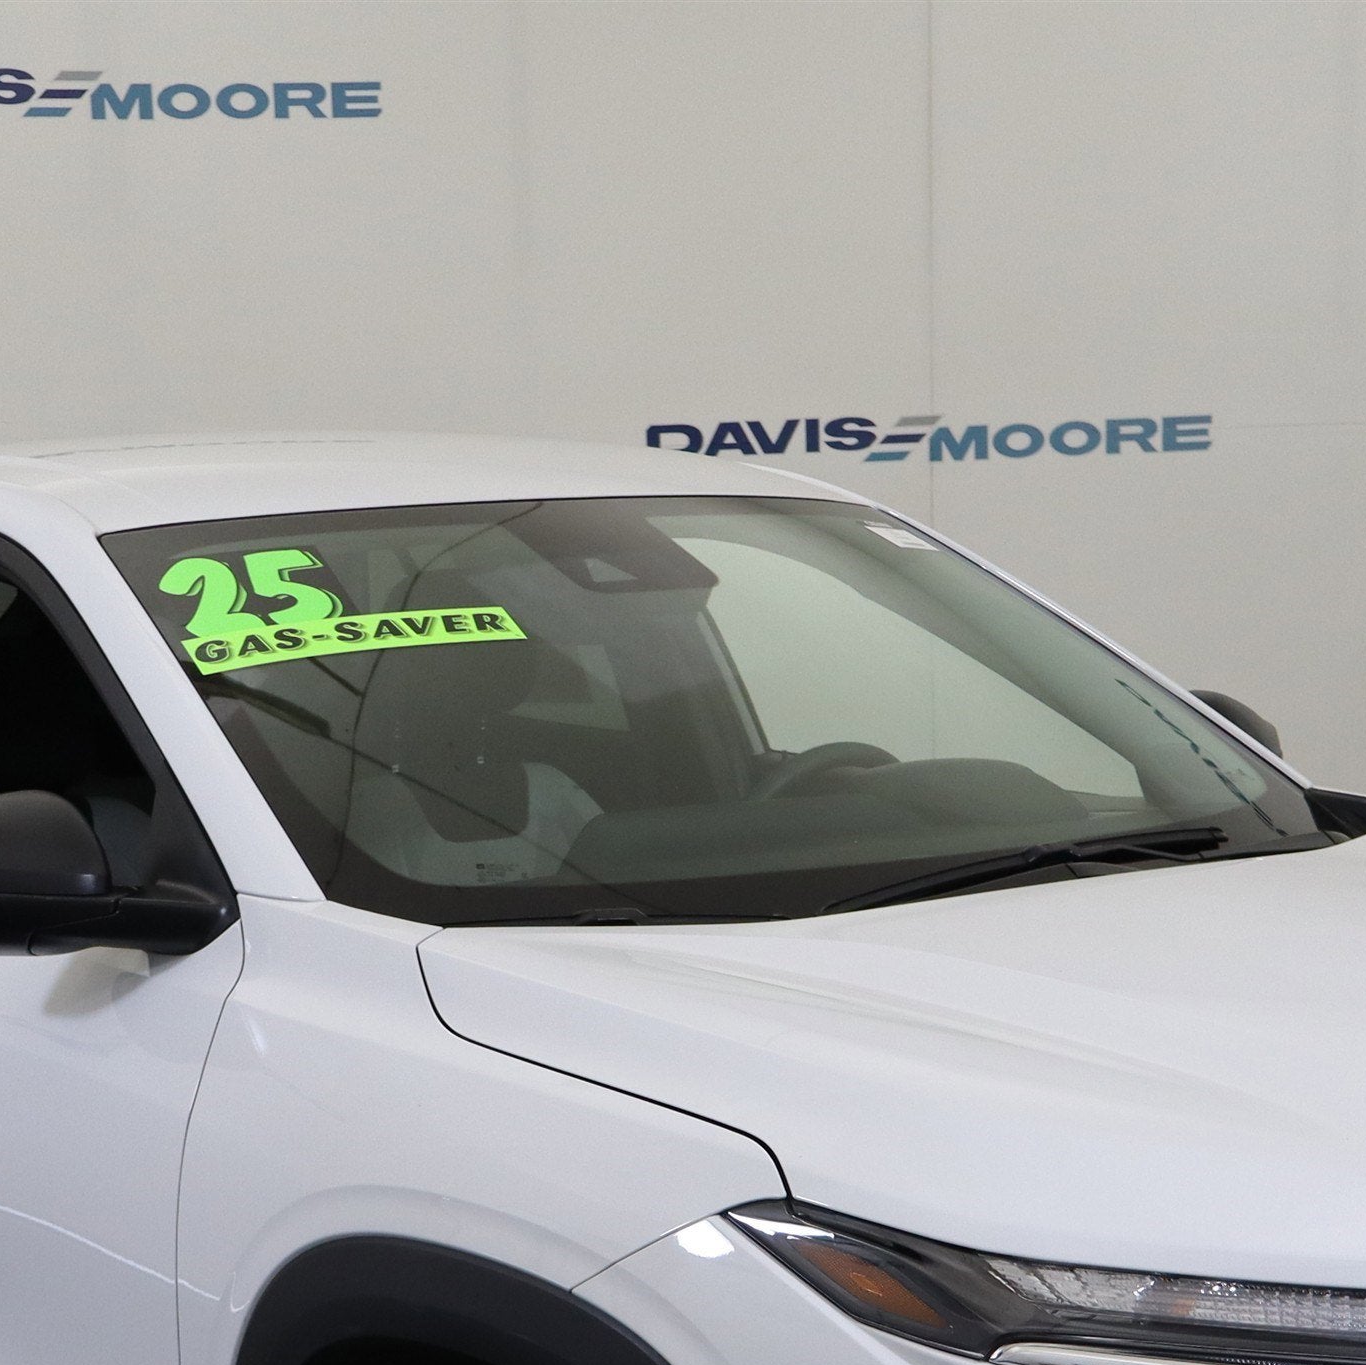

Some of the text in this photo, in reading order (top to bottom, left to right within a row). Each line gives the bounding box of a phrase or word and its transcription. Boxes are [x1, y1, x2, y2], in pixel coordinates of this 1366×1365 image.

[90, 81, 383, 120] MOORE
[645, 414, 1212, 462] DAVIS MOORE
[158, 549, 344, 638] 25
[194, 613, 506, 663] GAS-SAVER
